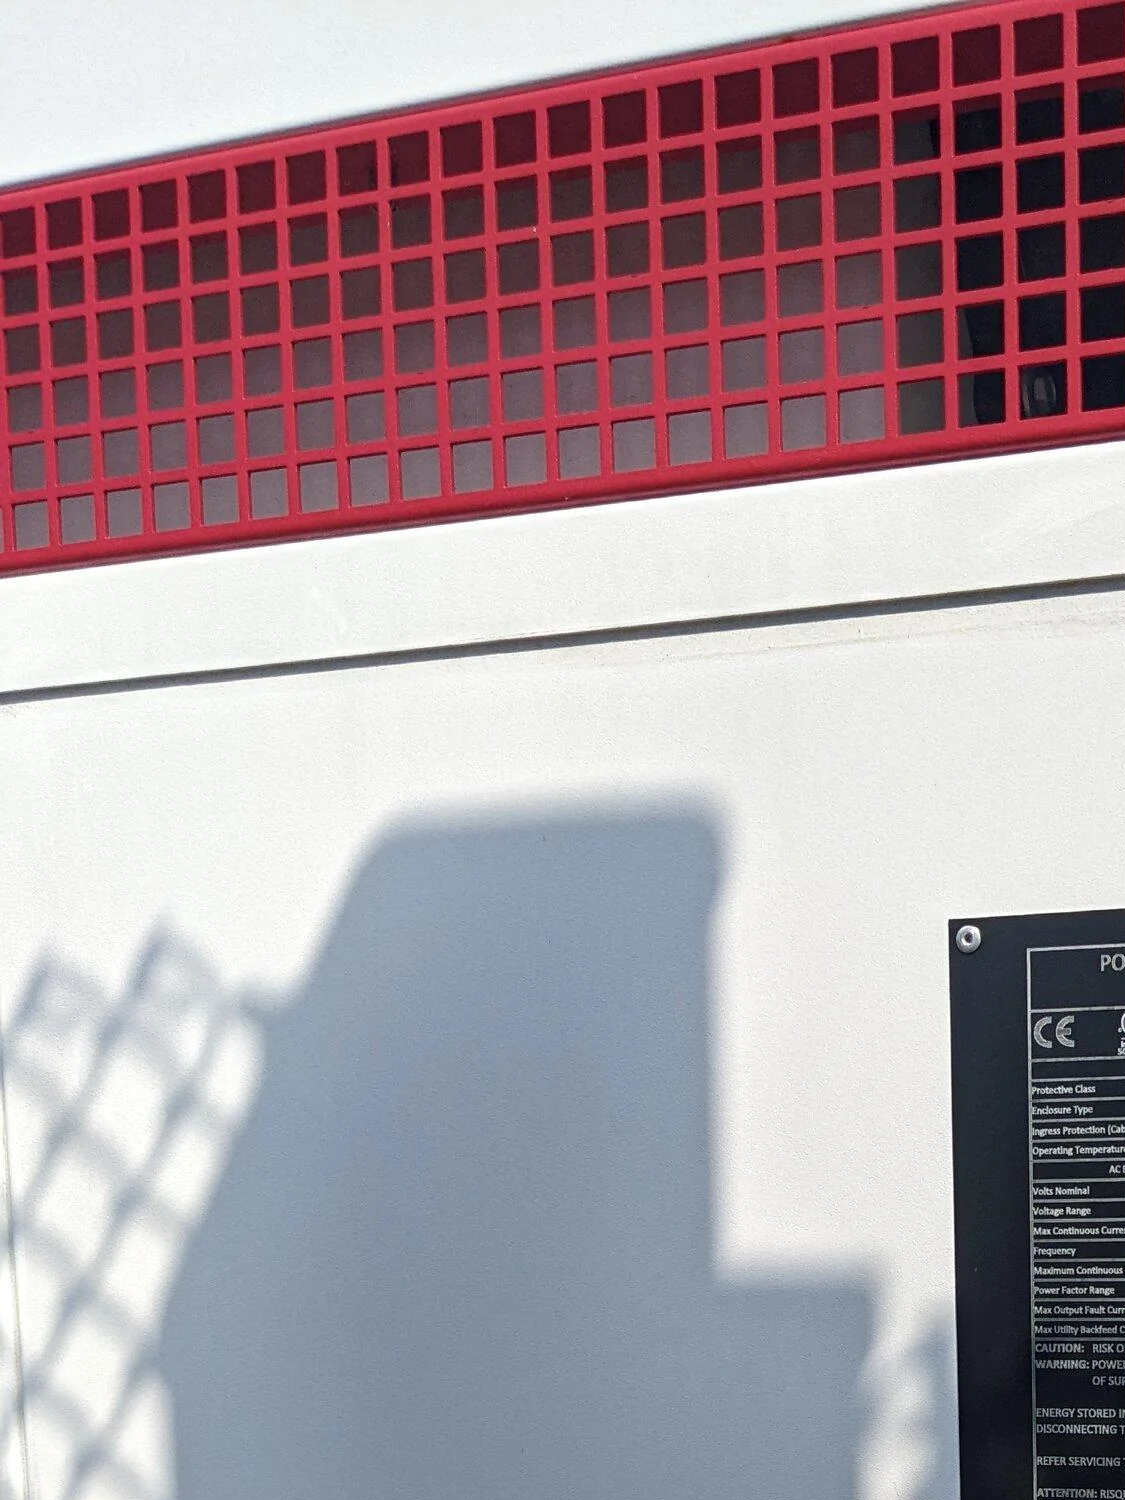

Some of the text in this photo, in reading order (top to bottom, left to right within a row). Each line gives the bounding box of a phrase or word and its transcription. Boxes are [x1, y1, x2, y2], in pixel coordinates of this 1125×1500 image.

[1033, 1016, 1075, 1048] CE
[1031, 1084, 1096, 1094] Protective Class
[1032, 1104, 1093, 1115] Enclosure Type
[1032, 1128, 1061, 1137] Ingress
[1062, 1125, 1105, 1134] Protection
[1032, 1146, 1073, 1157] Operating
[1108, 1164, 1121, 1174] AC
[1032, 1186, 1090, 1195] Volts Nominal
[1033, 1206, 1091, 1216] Voltage Range
[1033, 1227, 1051, 1235] Max
[1052, 1226, 1099, 1235] Continuous
[1033, 1247, 1076, 1257] Frequency
[1034, 1267, 1074, 1275] Maximum
[1075, 1265, 1123, 1274] Continuous
[1061, 1285, 1088, 1294] Factor
[1088, 1285, 1115, 1296] Range
[1034, 1306, 1052, 1314] Max
[1053, 1305, 1083, 1315] Output
[1084, 1305, 1106, 1314] Fault
[1035, 1344, 1084, 1353] CAUTION:
[1092, 1342, 1114, 1353] RISK
[1035, 1360, 1089, 1369] WARNING:
[1091, 1375, 1106, 1385] OF
[1036, 1408, 1075, 1417] ENERGY
[1076, 1408, 1116, 1418] STORED
[1036, 1424, 1117, 1434] DISCONNECTING
[1036, 1456, 1066, 1467] REFER
[1068, 1456, 1120, 1466] SERVICING
[1037, 1488, 1097, 1498] ATTENTION:
